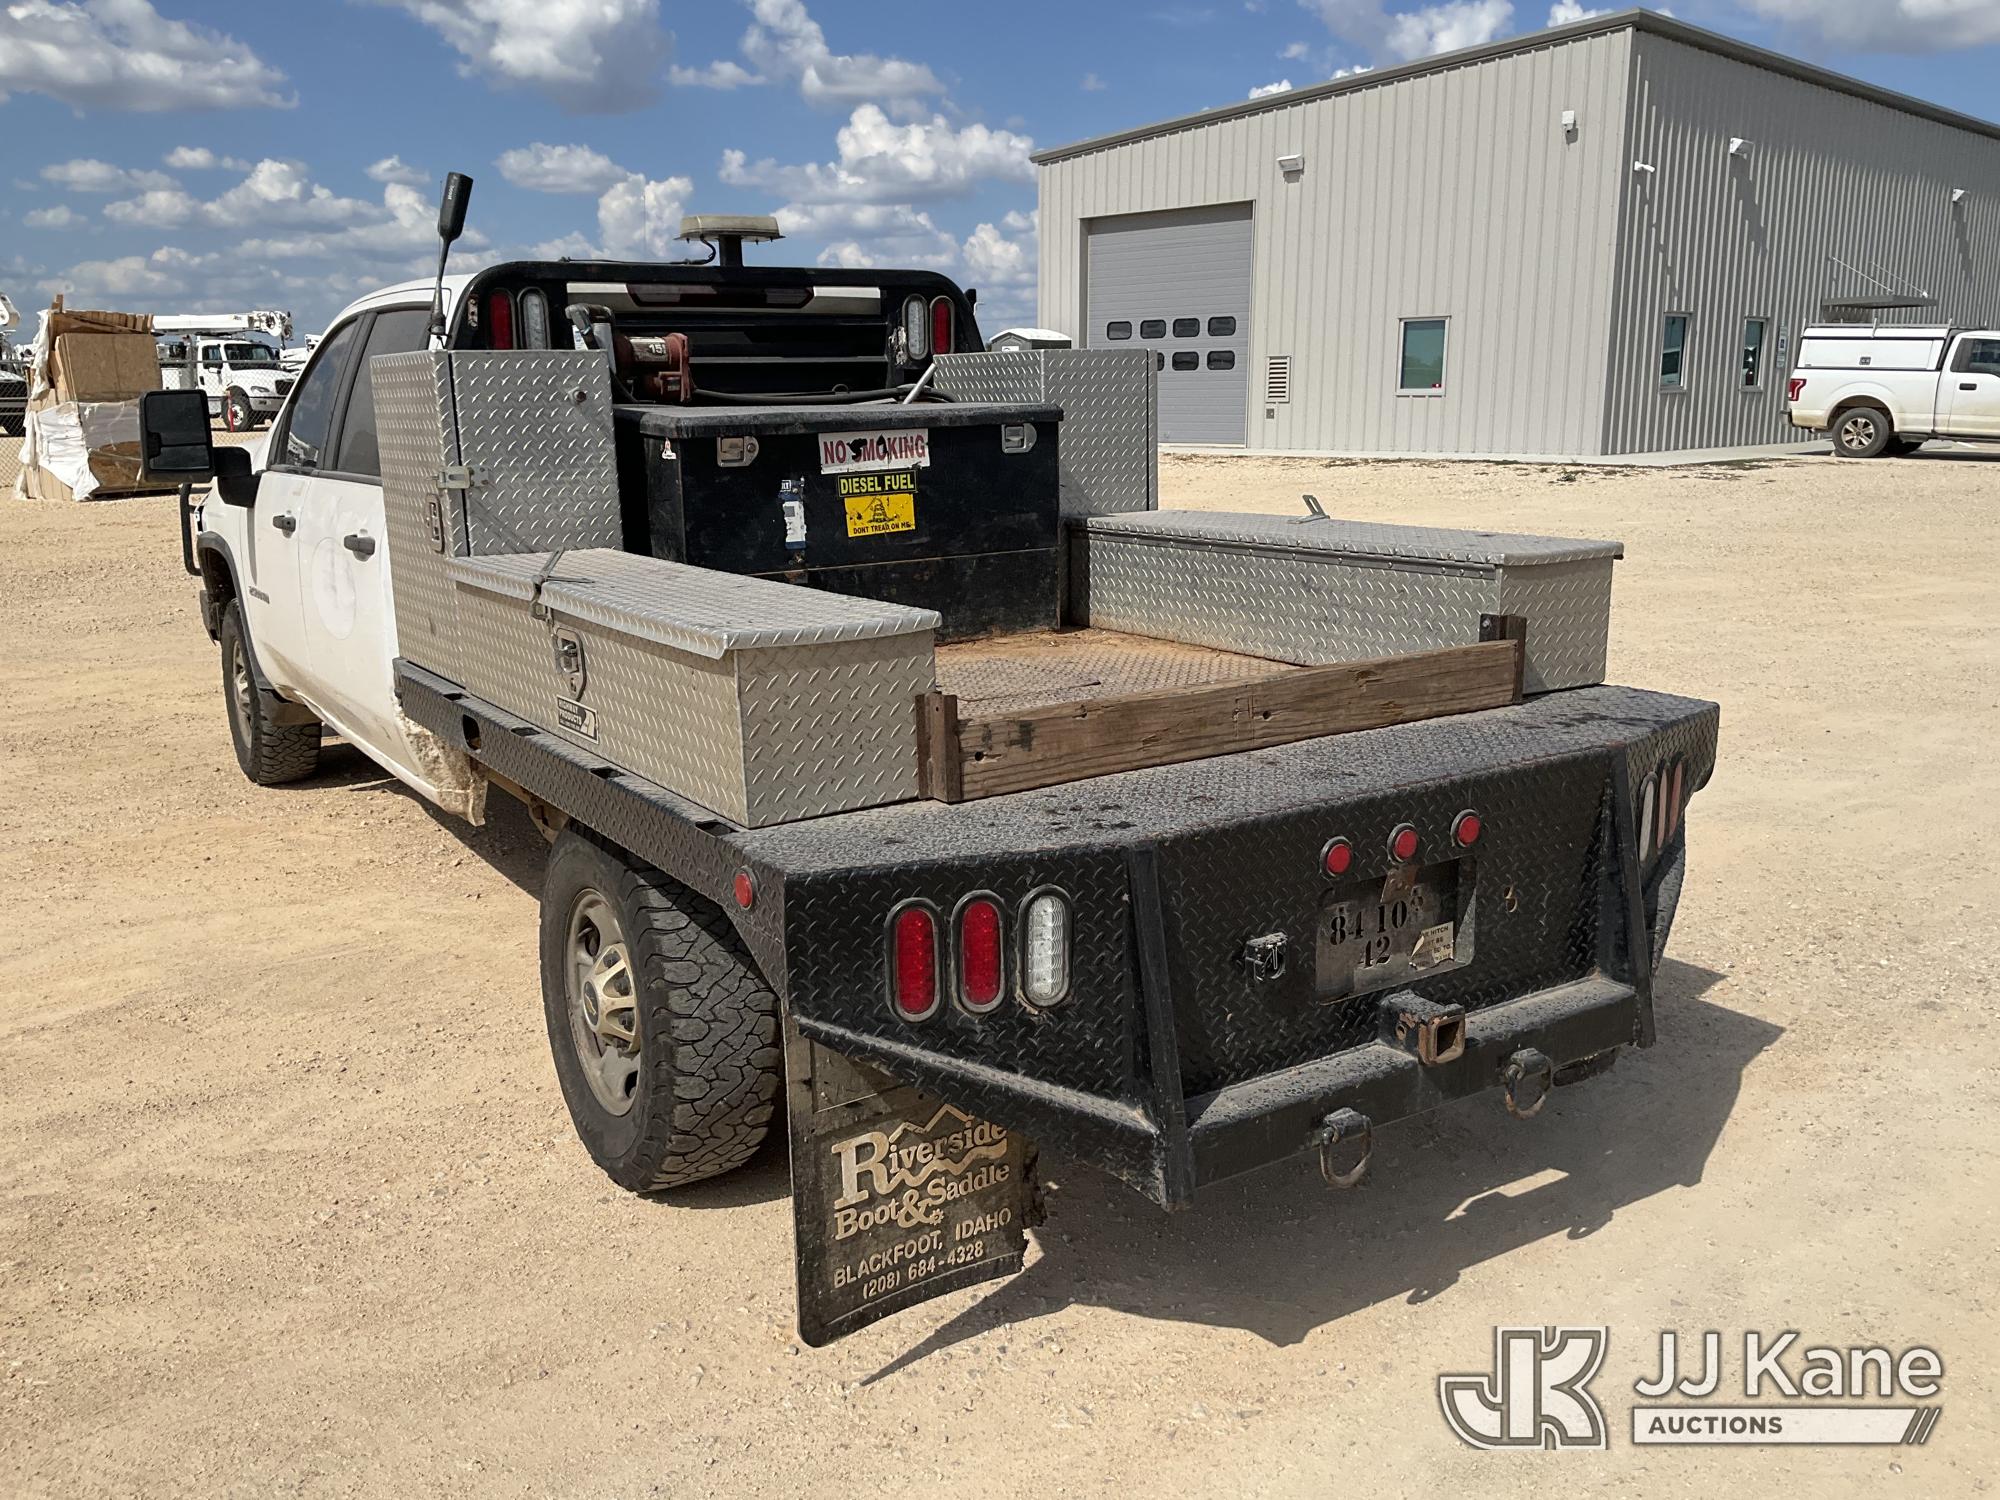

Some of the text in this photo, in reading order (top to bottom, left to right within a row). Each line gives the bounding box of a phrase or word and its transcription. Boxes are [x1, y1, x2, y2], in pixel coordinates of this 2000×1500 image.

[823, 440, 847, 464] NO
[840, 474, 914, 494] DIESEL FUEL
[853, 526, 869, 534] DONT
[871, 523, 890, 532] TREAD
[831, 1120, 1007, 1210] Riverside
[834, 1208, 1012, 1288] BLACKFOOT, IDAHO
[863, 1270, 900, 1299] (208)
